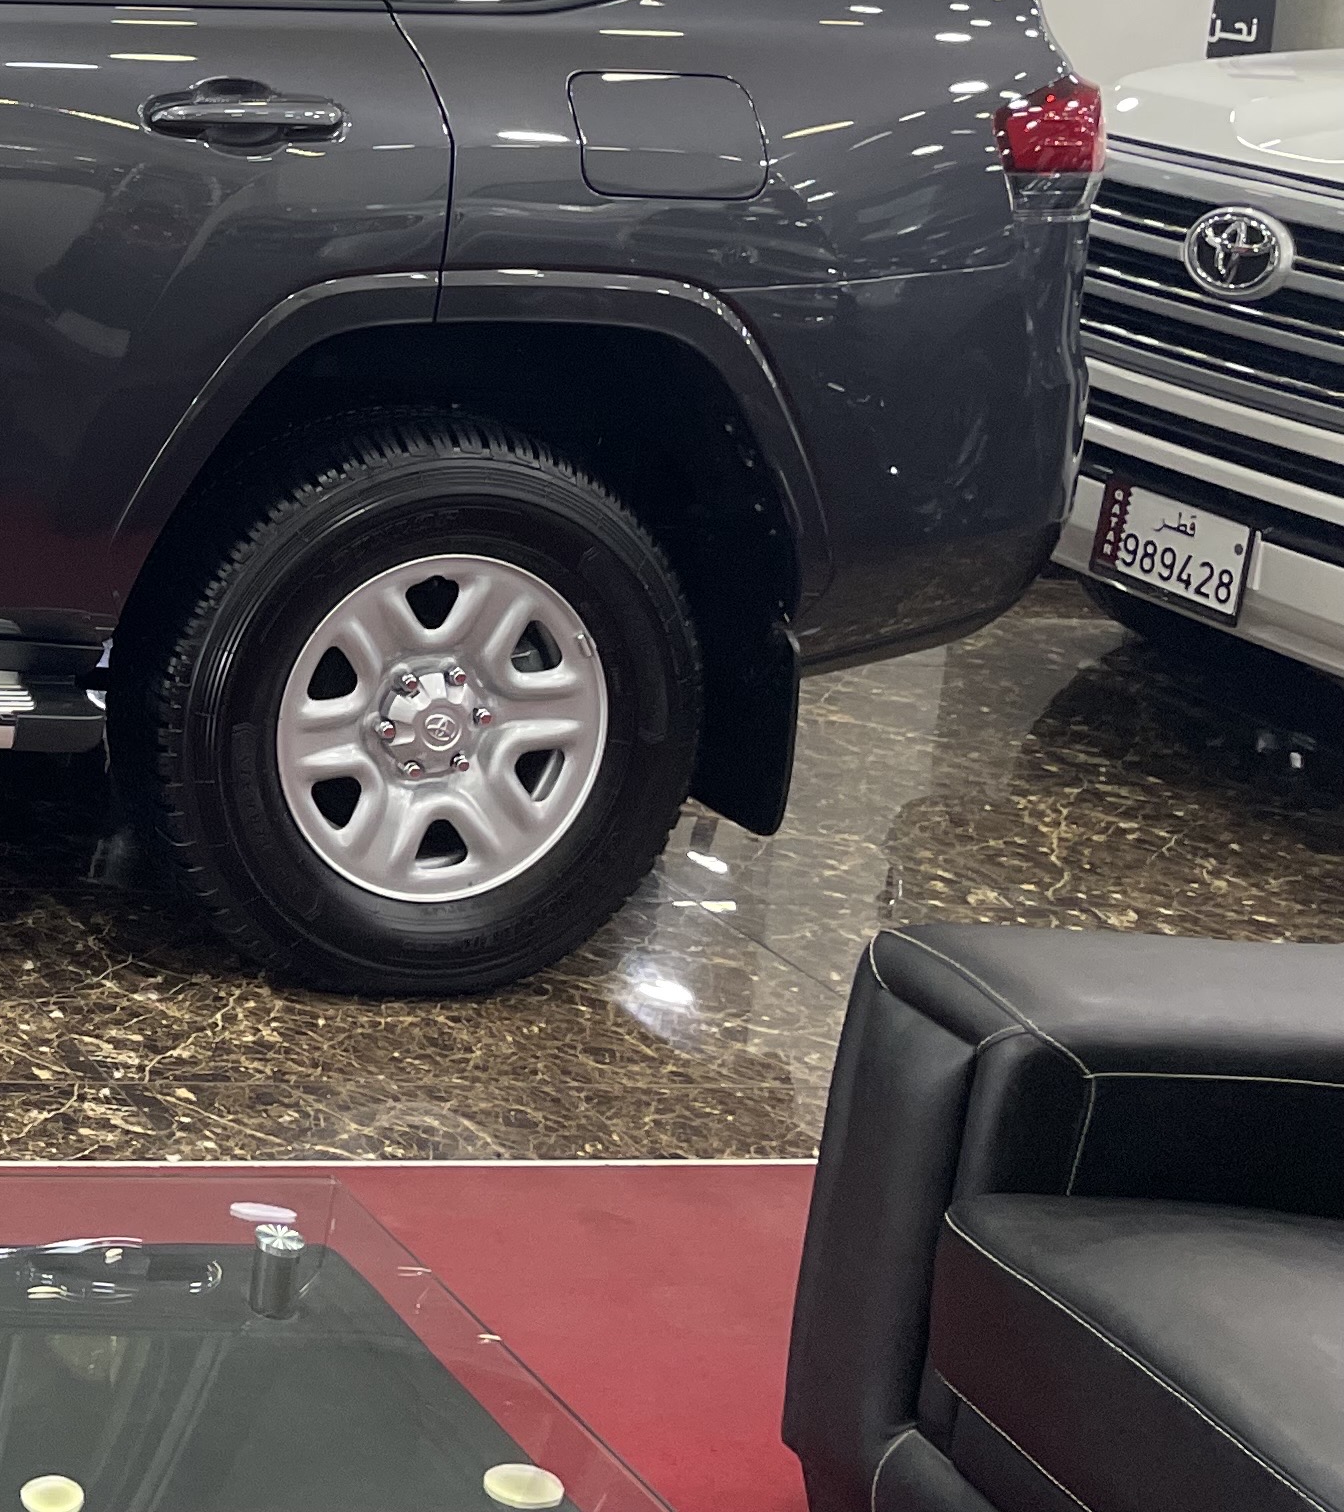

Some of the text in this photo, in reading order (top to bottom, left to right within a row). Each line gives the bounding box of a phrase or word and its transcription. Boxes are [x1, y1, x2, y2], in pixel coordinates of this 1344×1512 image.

[1102, 489, 1124, 556] QATAR
[1153, 511, 1197, 538] قطر
[1122, 533, 1234, 604] 989428
